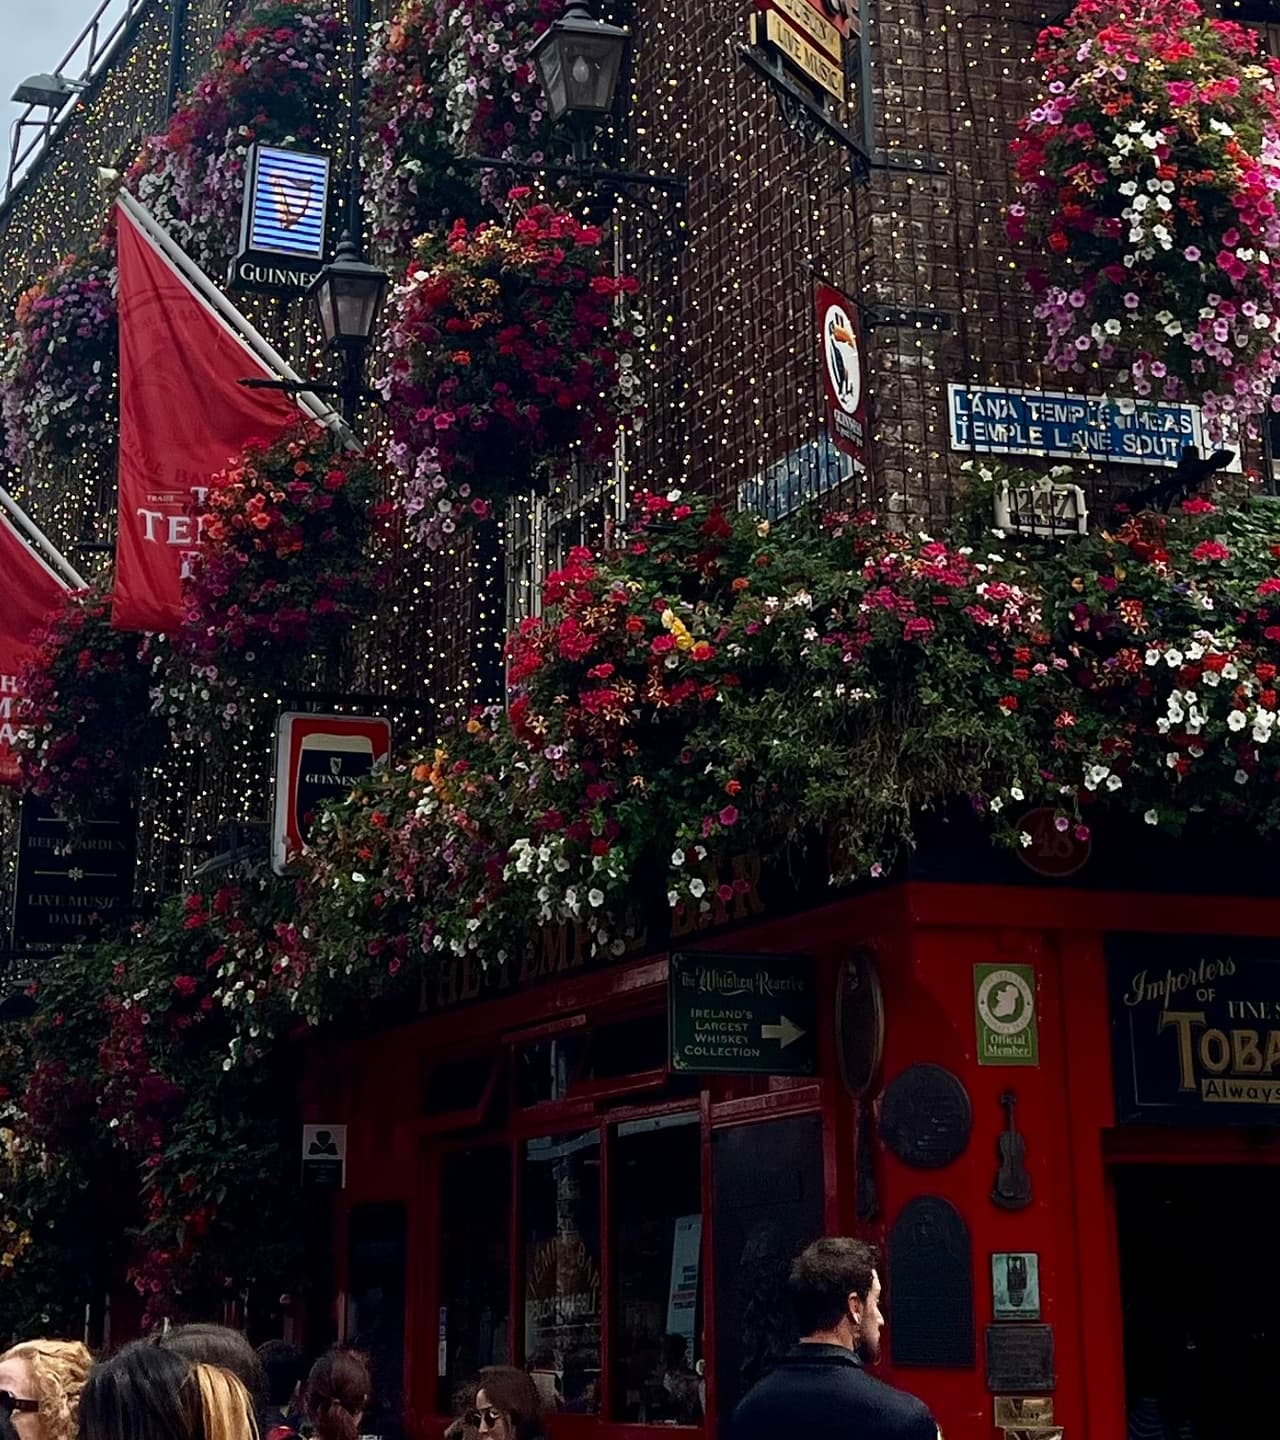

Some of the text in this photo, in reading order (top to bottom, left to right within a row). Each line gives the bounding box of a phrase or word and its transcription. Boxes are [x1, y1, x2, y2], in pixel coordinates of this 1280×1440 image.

[777, 20, 839, 91] LIVE MUSIC
[240, 262, 318, 288] GUINNES
[1026, 401, 1111, 425] TEMPLE
[958, 420, 1193, 457] TEMPLE LANE SOUT
[1195, 987, 1217, 1003] OF
[690, 1007, 753, 1019] IRELAND'S
[1226, 999, 1273, 1021] FINE
[695, 1020, 749, 1033] LARGEST
[694, 1032, 749, 1045] WHISKEY
[990, 1033, 1026, 1046] Official
[684, 1044, 761, 1058] COLLECTION
[987, 1044, 1029, 1056] Member
